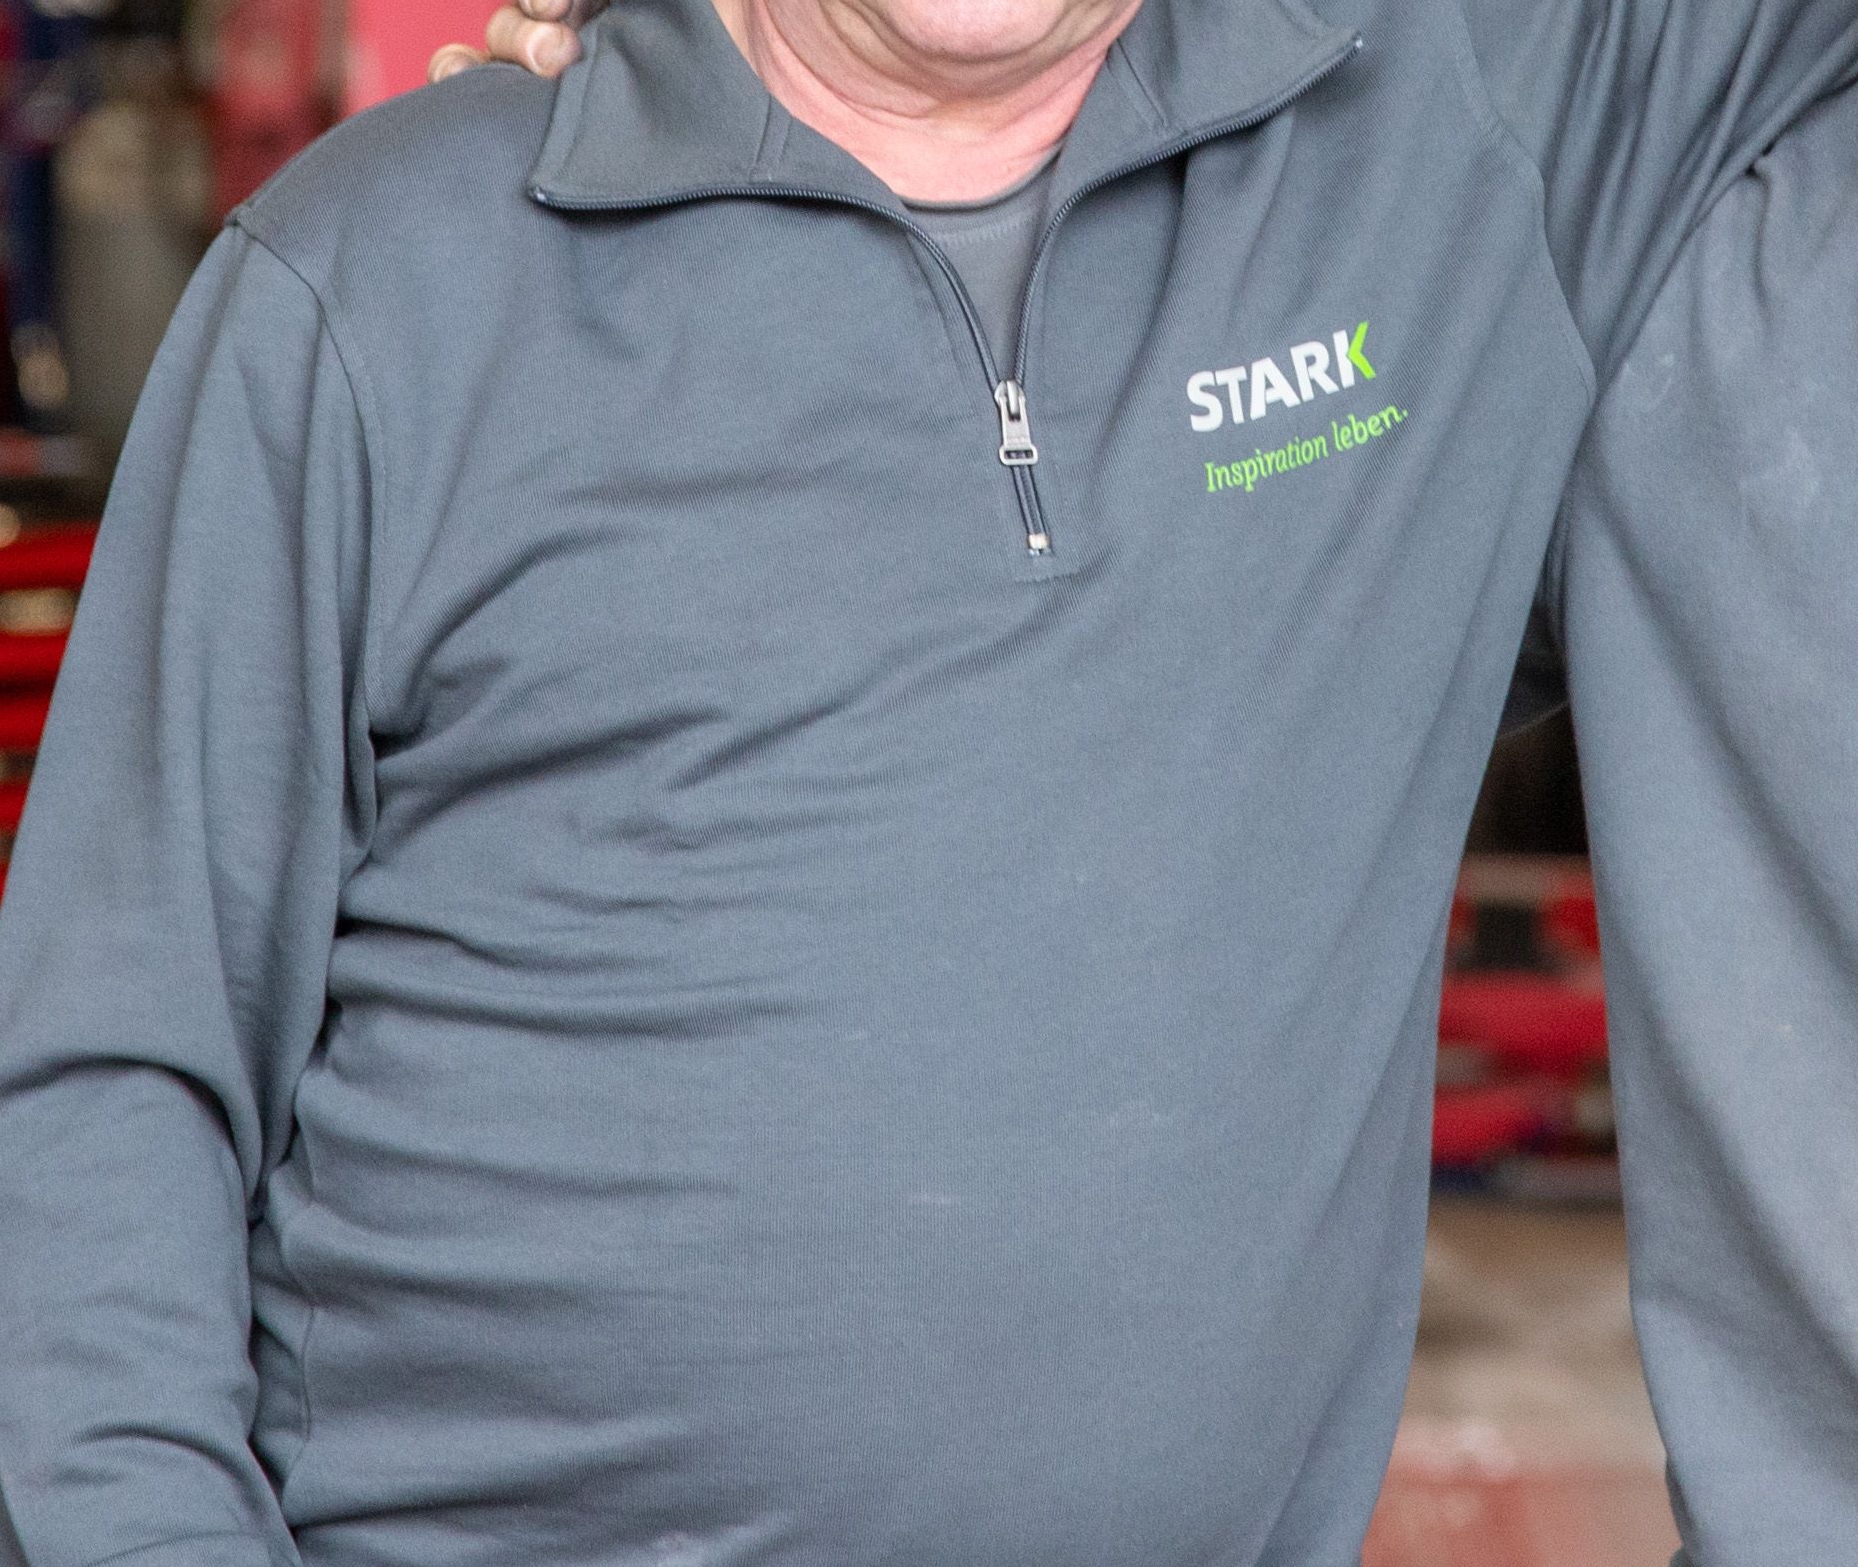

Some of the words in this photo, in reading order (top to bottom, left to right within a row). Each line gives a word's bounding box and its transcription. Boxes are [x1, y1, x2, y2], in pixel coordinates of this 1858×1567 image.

[1186, 321, 1376, 432] STARK
[1204, 433, 1329, 493] Inspiration
[1331, 405, 1408, 451] leben.
